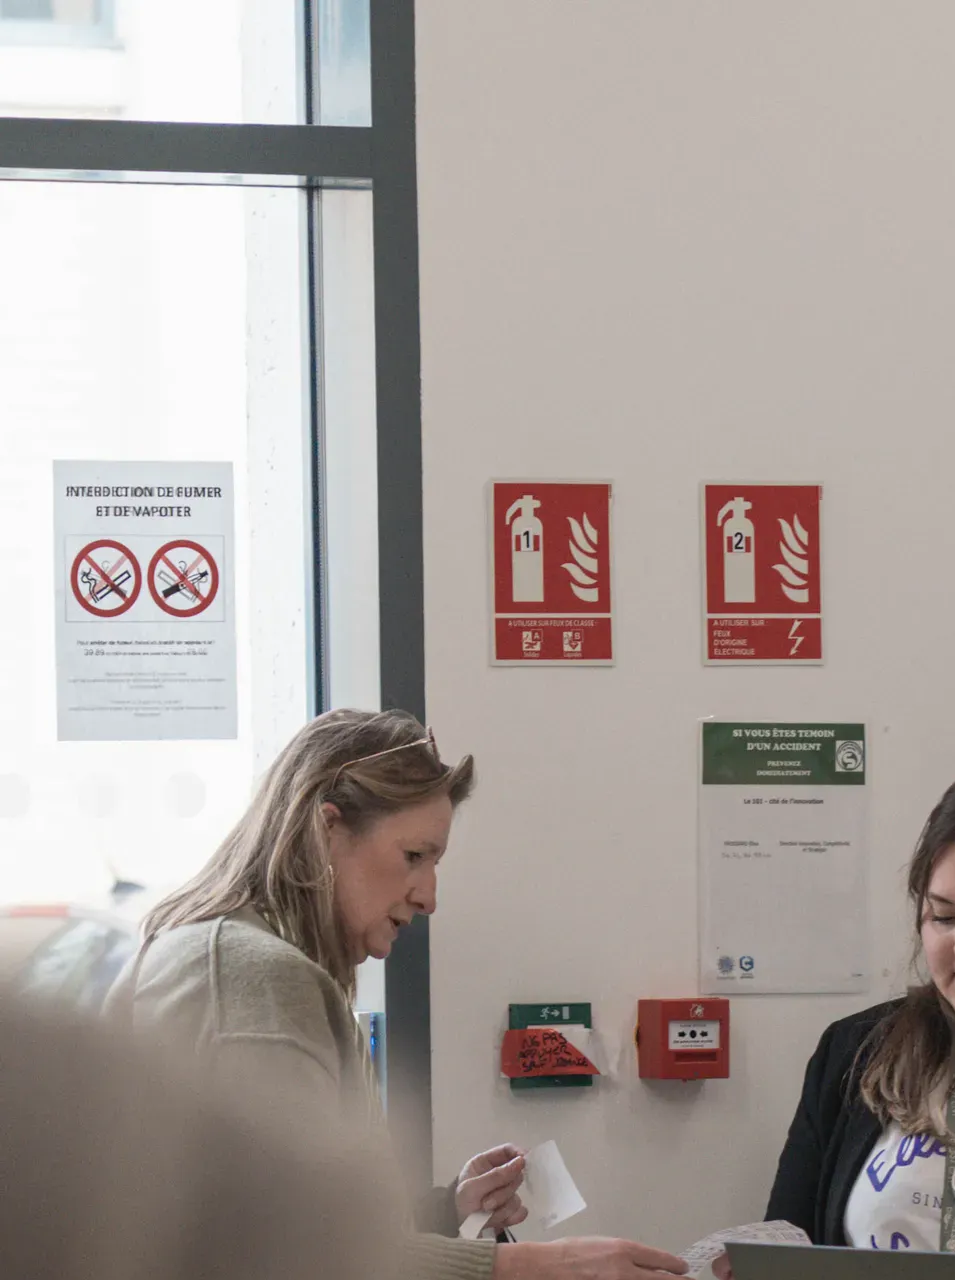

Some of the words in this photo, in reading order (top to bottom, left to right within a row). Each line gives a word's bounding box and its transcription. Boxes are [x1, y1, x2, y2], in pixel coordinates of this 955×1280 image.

[66, 486, 155, 498] INTERDICTION
[157, 486, 174, 498] DE
[176, 486, 222, 498] FUMER
[96, 505, 110, 517] ET
[113, 505, 130, 517] DE
[132, 505, 192, 517] VAPOTER
[522, 530, 530, 549] 1
[734, 531, 744, 550] 2
[732, 729, 743, 737] SI
[744, 729, 771, 738] VOUS
[772, 728, 797, 738] ÊTES
[798, 730, 835, 738] TEMOIN
[747, 742, 771, 751] D'UN
[772, 742, 822, 751] ACCIDENT
[542, 1031, 568, 1046] PAS
